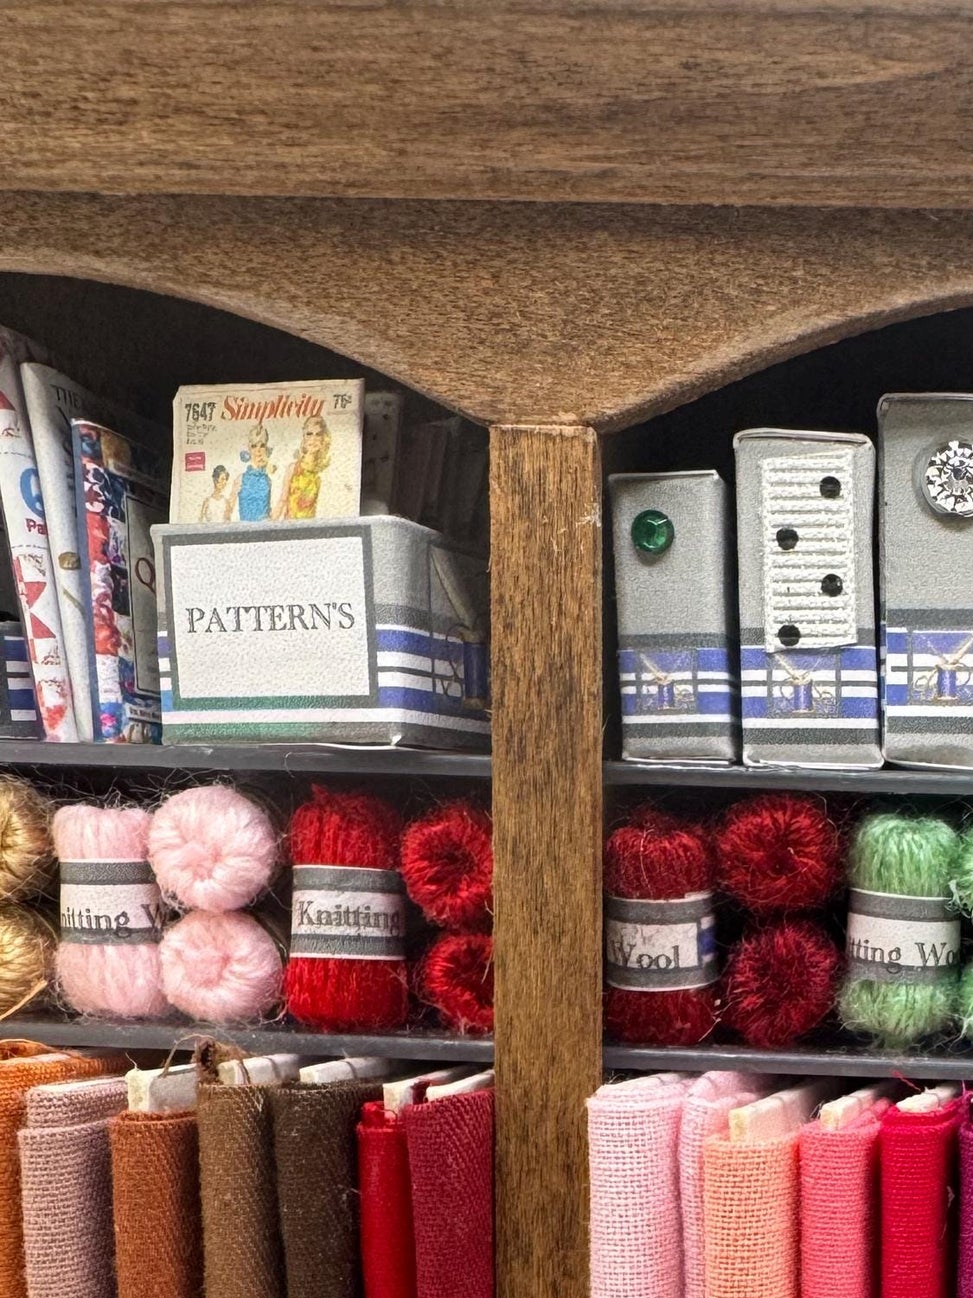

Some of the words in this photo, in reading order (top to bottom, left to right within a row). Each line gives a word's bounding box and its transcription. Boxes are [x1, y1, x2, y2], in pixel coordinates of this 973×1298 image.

[185, 402, 216, 422] 7647
[221, 393, 326, 426] Simplicity
[185, 603, 355, 633] PATTERN'S
[298, 900, 400, 936] Knitting
[609, 941, 680, 970] Wool
